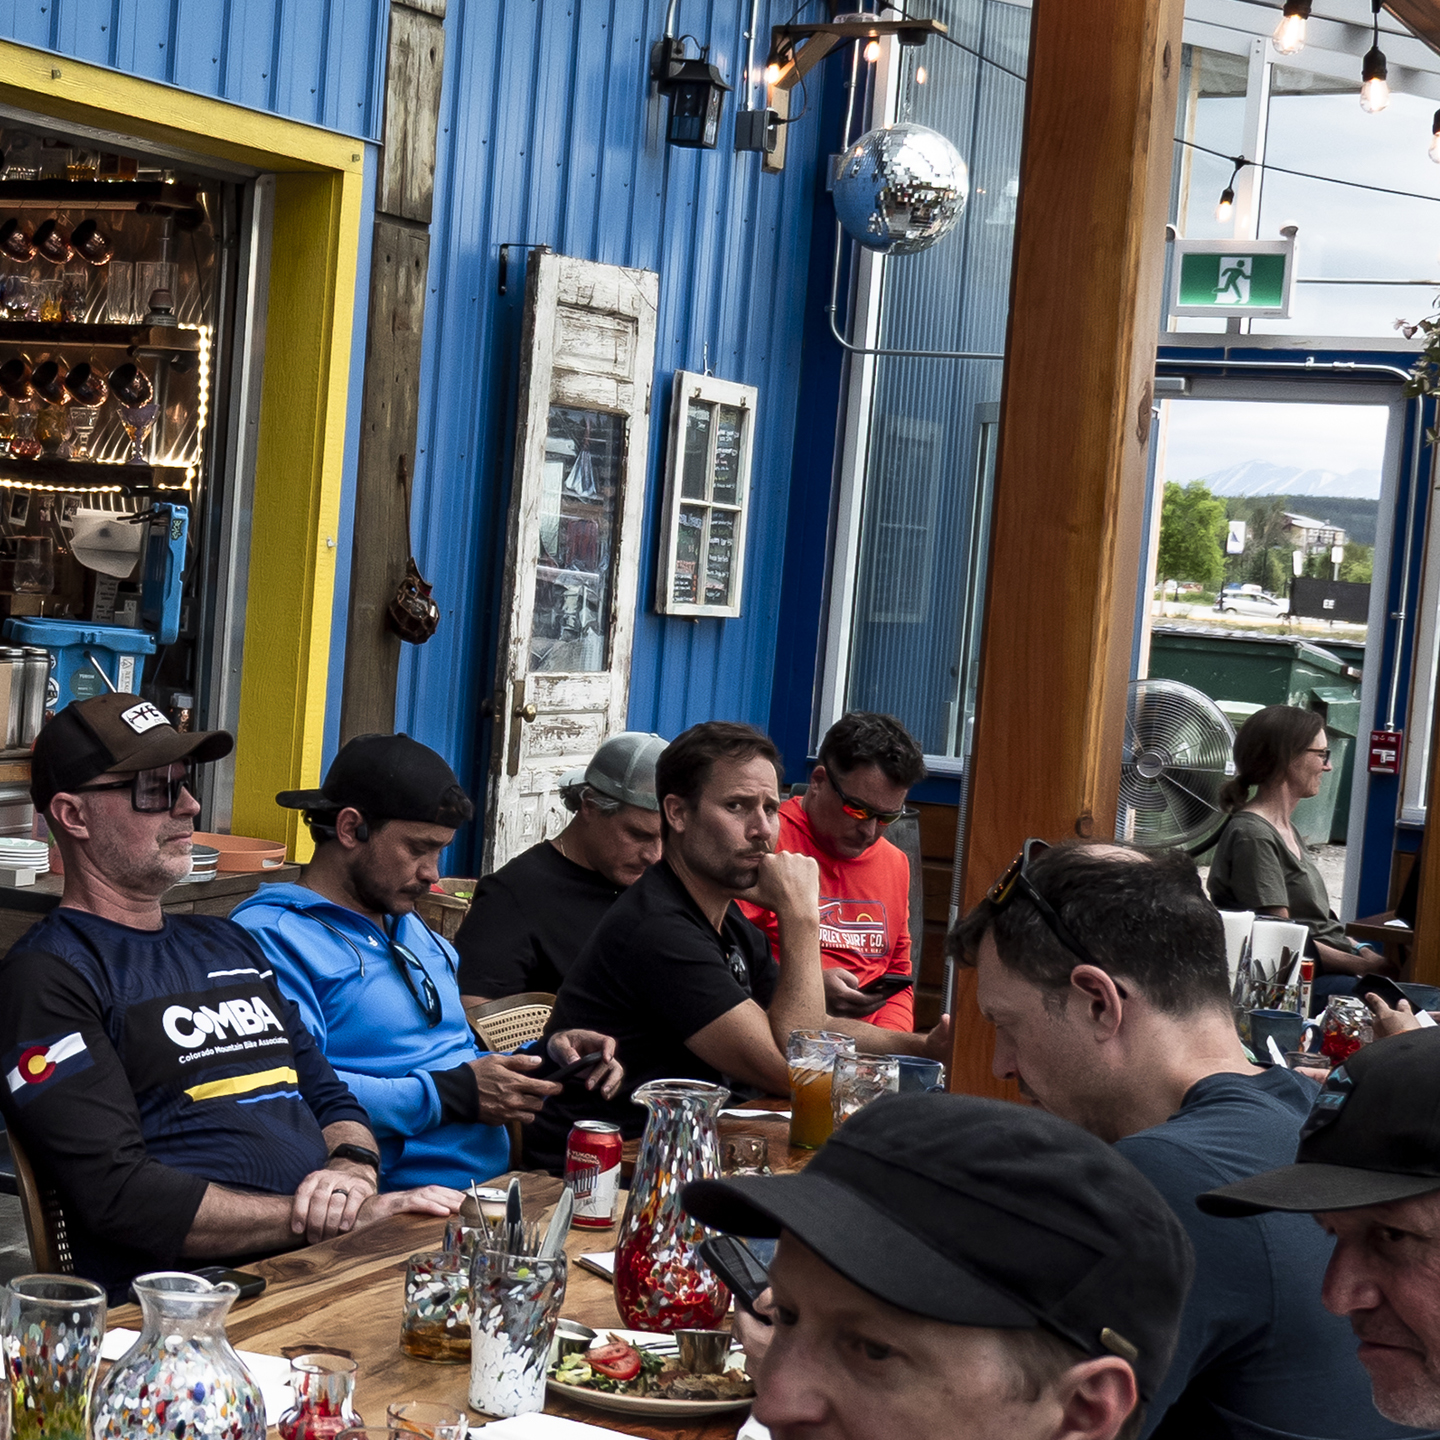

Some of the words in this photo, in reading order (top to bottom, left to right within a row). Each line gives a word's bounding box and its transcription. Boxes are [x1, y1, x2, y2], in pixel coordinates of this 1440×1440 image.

[819, 929, 841, 943] URLEY
[842, 933, 867, 947] SURF
[870, 934, 884, 947] CO.
[178, 1047, 215, 1064] Colorado
[214, 1042, 244, 1054] Mountain
[243, 1040, 258, 1050] Bike
[571, 1150, 598, 1160] YUKON
